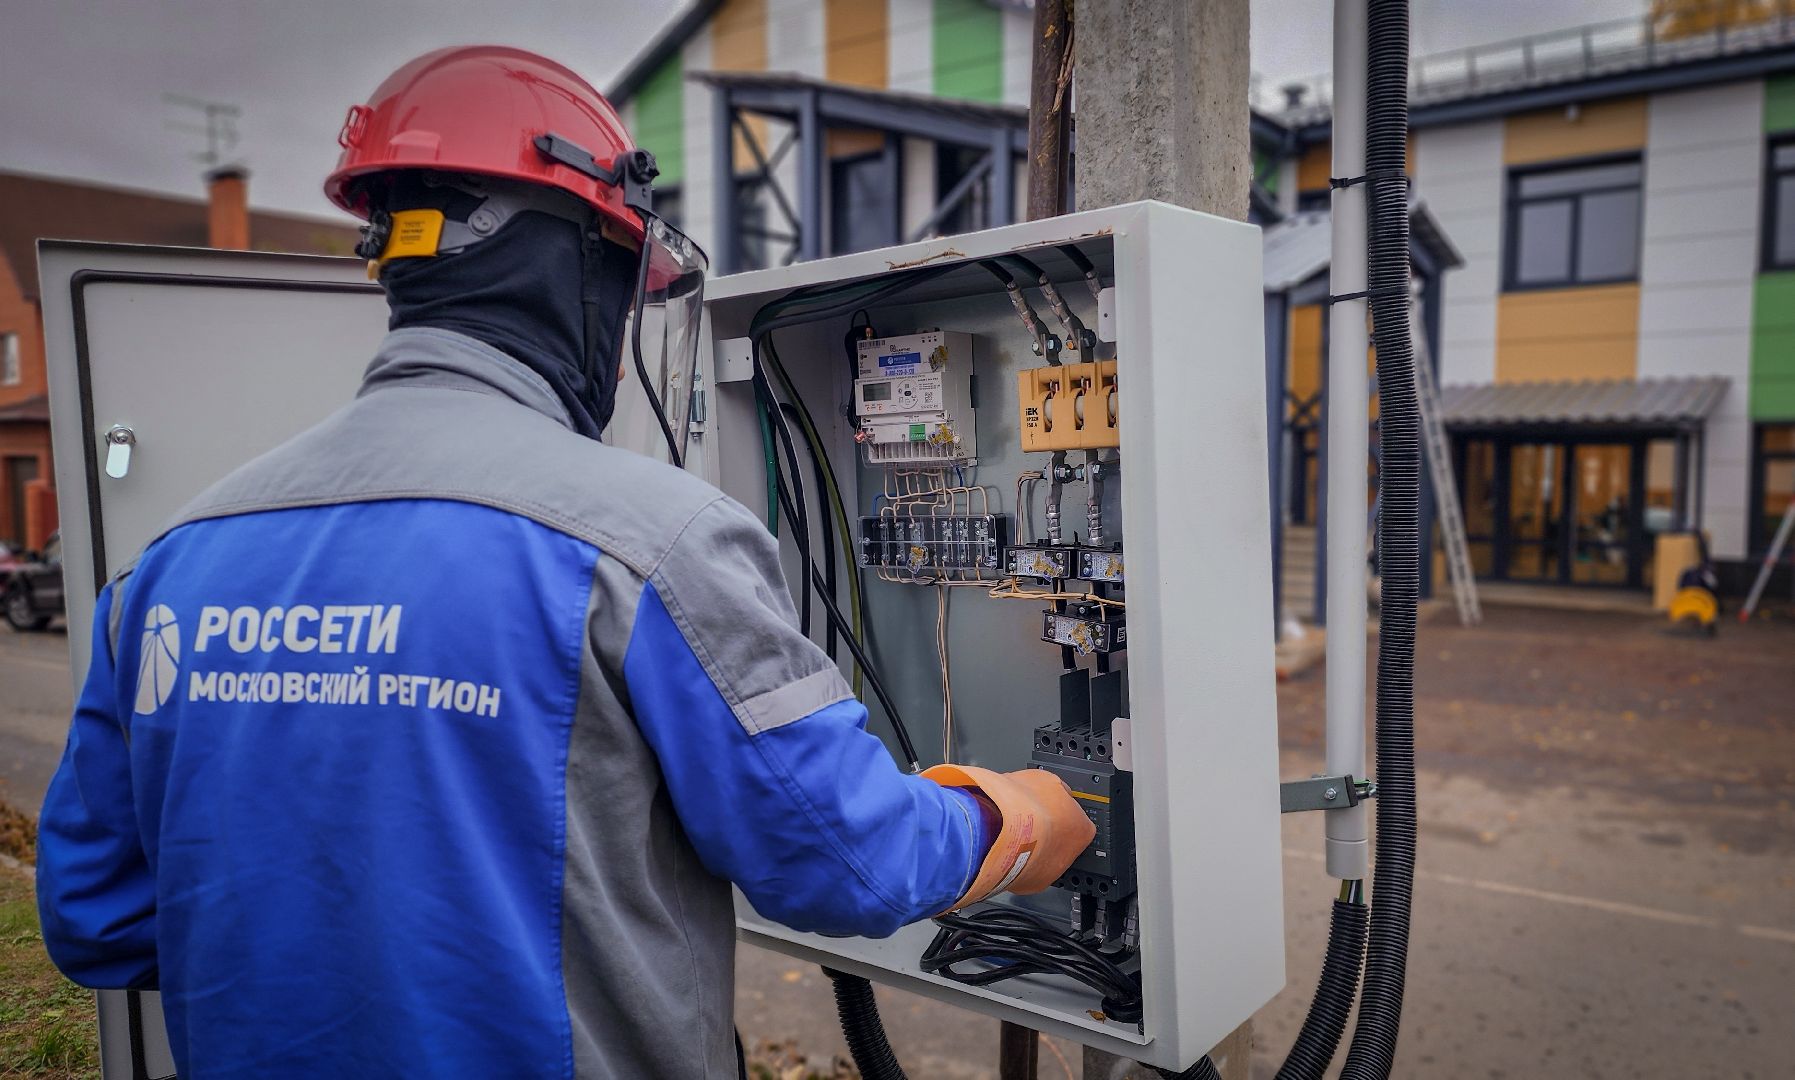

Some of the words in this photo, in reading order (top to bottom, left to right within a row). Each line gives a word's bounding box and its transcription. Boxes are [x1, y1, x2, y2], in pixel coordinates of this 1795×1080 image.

[194, 604, 402, 654] РОССЕТИ
[188, 666, 369, 705] МОСКОВСКИЙ
[378, 674, 501, 718] РЕГИОН
